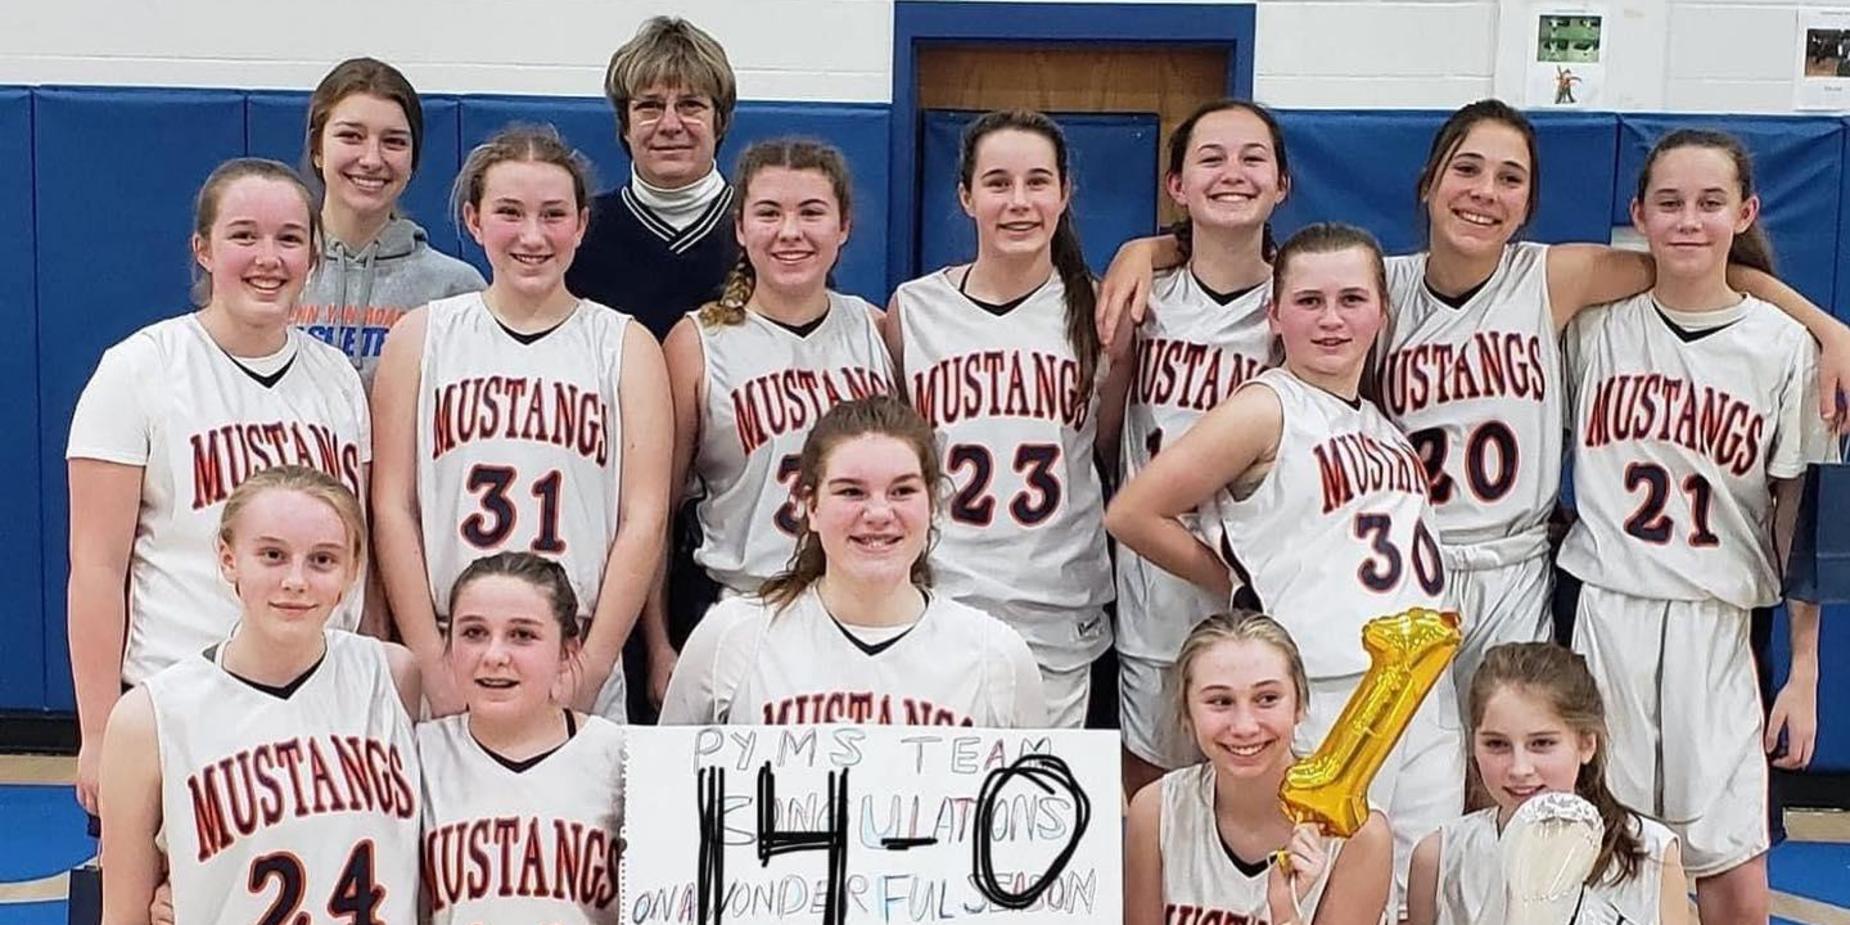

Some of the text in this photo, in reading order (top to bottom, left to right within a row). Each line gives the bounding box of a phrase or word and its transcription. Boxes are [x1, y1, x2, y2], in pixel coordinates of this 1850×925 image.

[731, 367, 895, 458] MUSTAN
[1133, 338, 1269, 412] USTAN
[1380, 331, 1546, 415] USTANGS
[432, 375, 608, 468] MUSTANGS
[1585, 374, 1764, 477] MUSTANGS
[460, 463, 567, 554] 31
[947, 444, 1062, 528] 23
[1624, 461, 1721, 548] 21
[1354, 513, 1446, 597] 30
[694, 727, 1053, 776] PYMS TEAM
[187, 735, 415, 862] MUSTANGS
[247, 838, 387, 925] 24
